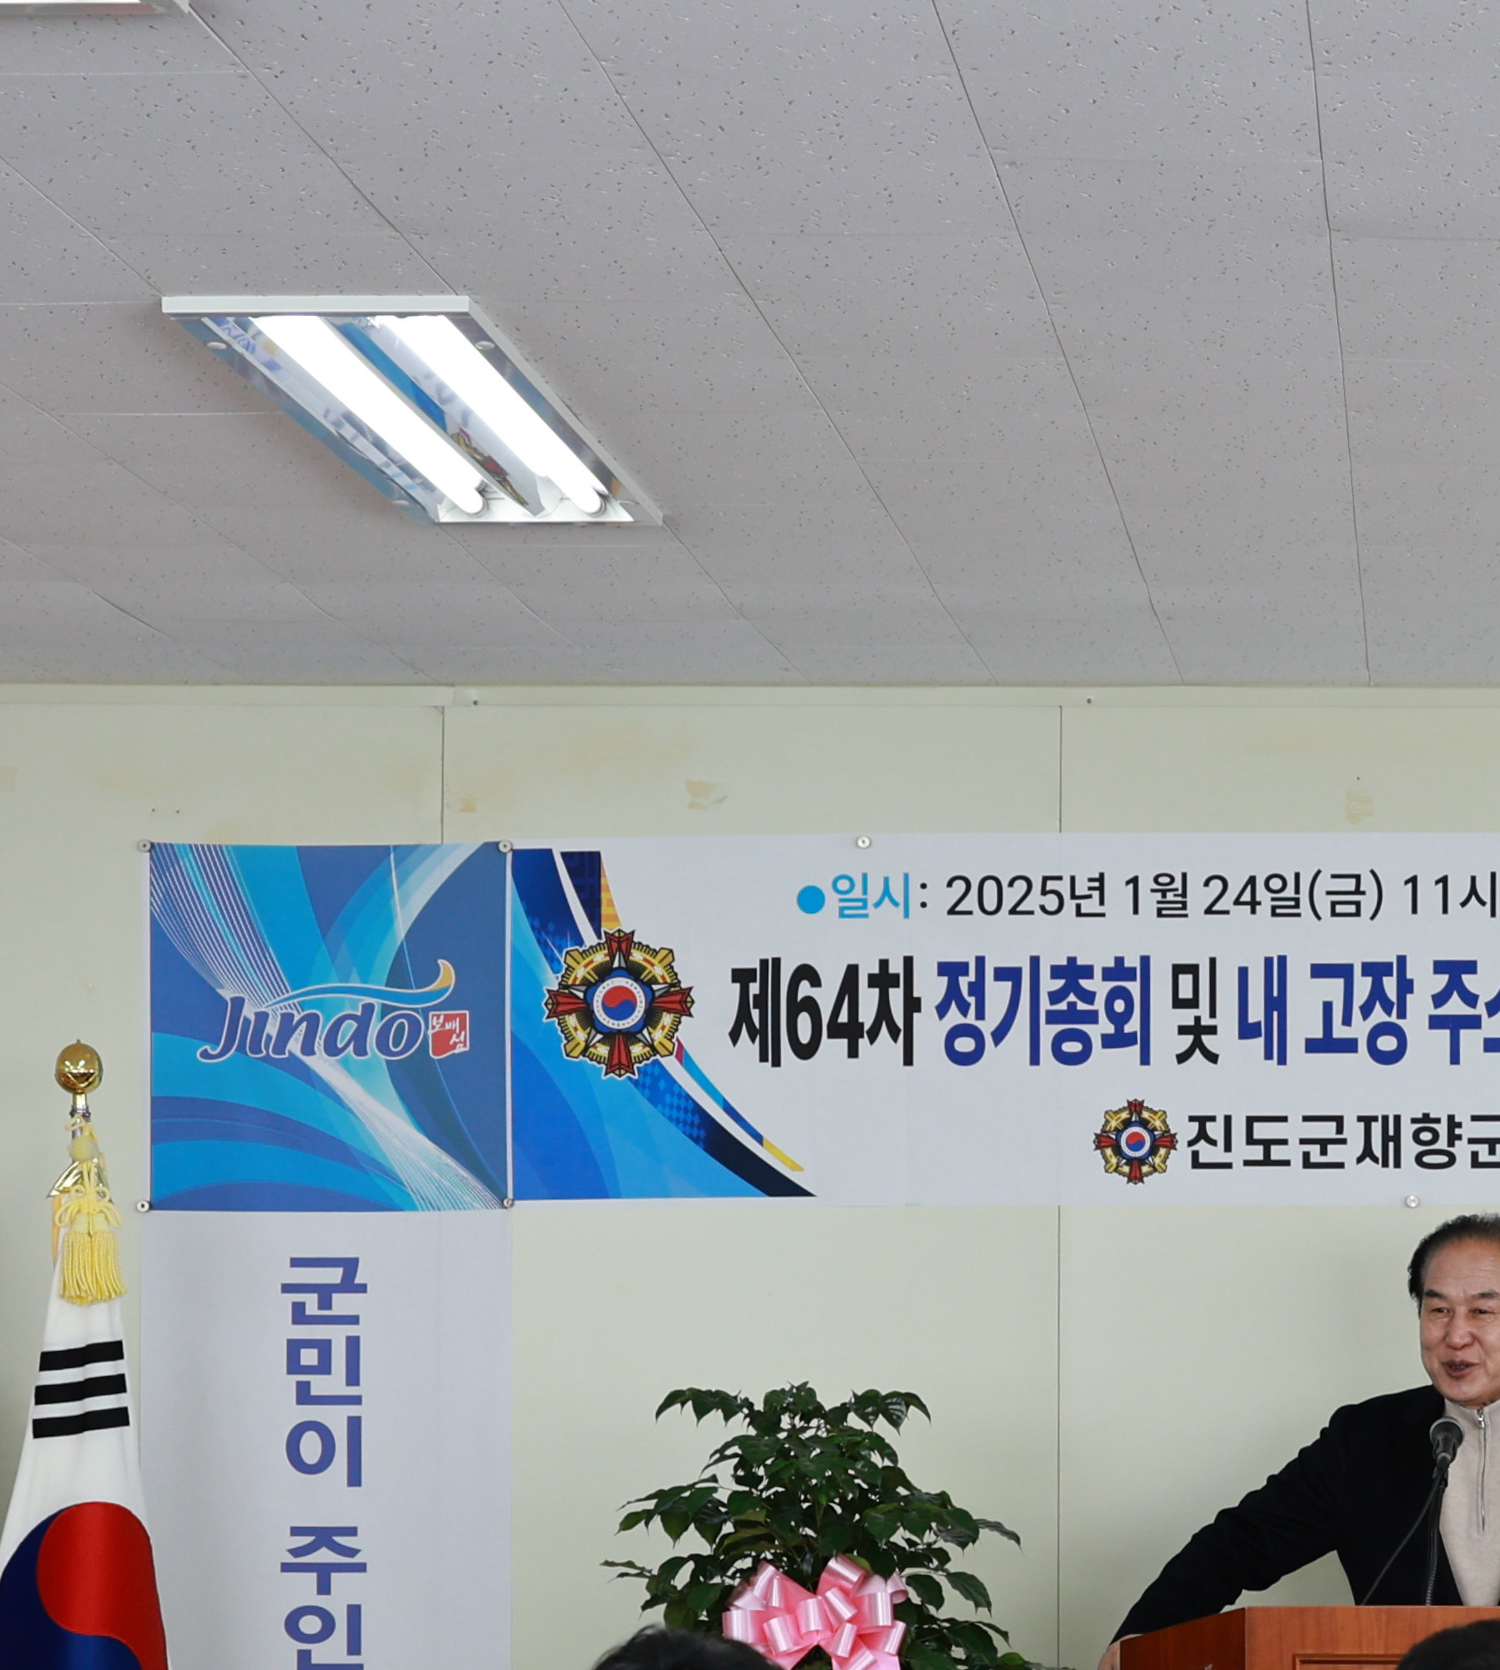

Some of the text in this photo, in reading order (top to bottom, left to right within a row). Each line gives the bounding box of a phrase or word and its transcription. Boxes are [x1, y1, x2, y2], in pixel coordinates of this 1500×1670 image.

[833, 870, 1497, 922] 일시: 2025년 1월 24일(금) 11시
[197, 995, 424, 1062] Jindo
[729, 956, 923, 1069] 제64차
[936, 956, 1152, 1067] 정기총회
[1172, 958, 1220, 1066] 및
[1239, 956, 1288, 1067] 내
[1306, 956, 1415, 1066] 고장
[282, 1257, 368, 1488] 군민이
